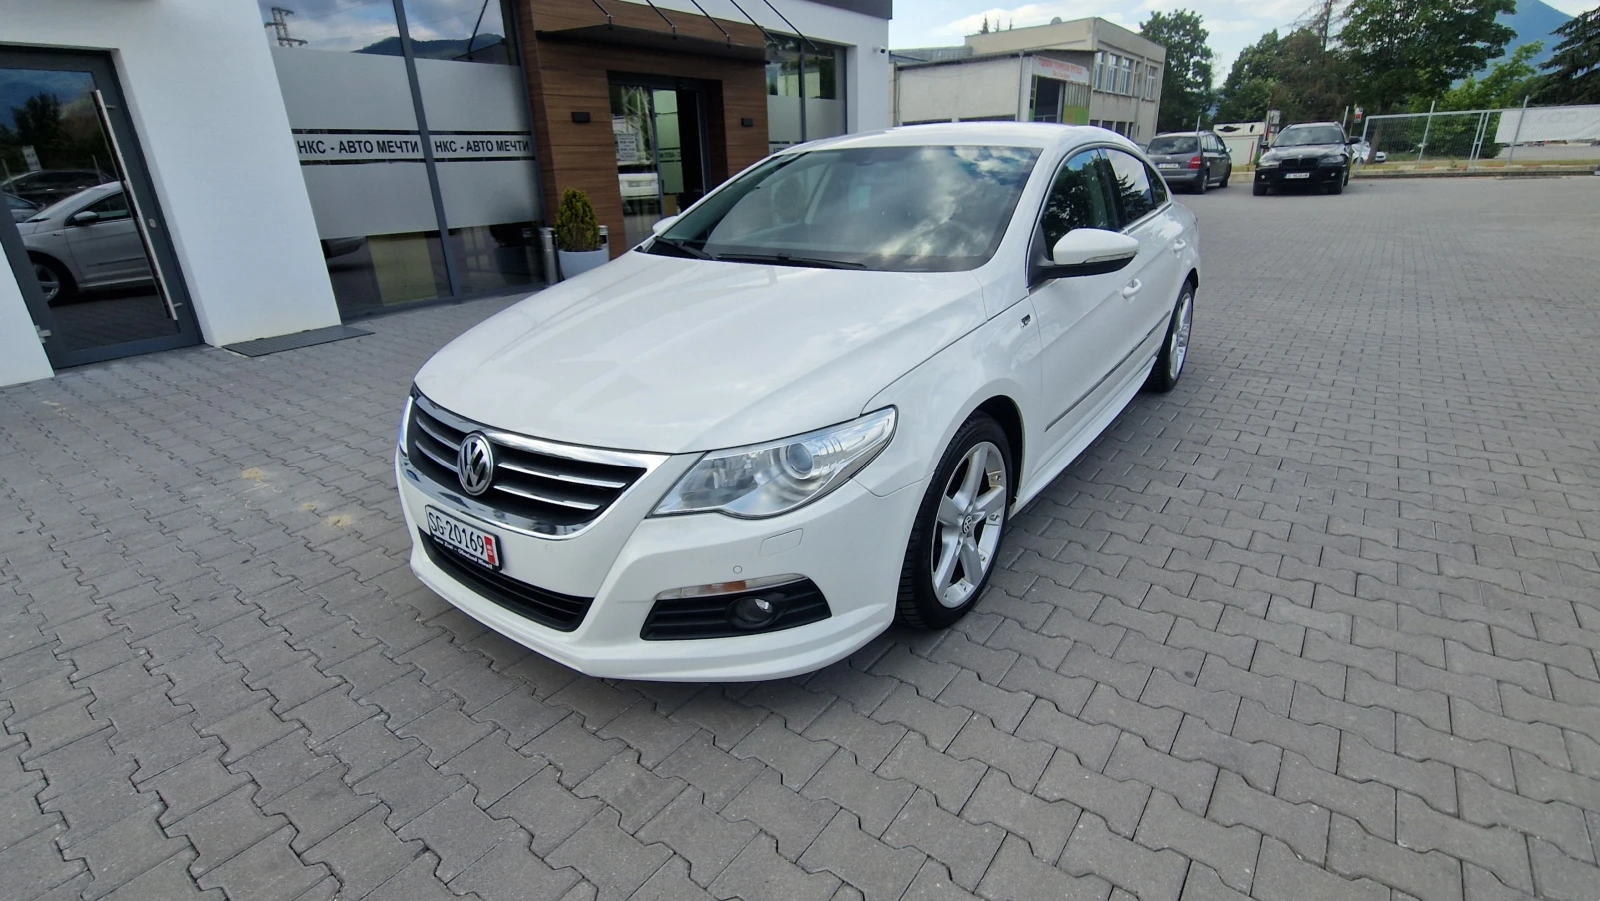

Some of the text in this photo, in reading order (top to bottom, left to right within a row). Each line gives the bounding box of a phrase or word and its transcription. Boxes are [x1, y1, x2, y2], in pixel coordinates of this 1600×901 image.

[297, 140, 326, 154] НКС
[339, 140, 374, 154] АВТО
[376, 140, 419, 153] МЕЧТИ
[434, 140, 457, 152] НКС
[466, 140, 493, 152] АВТО
[496, 140, 530, 151] МЕЧТИ
